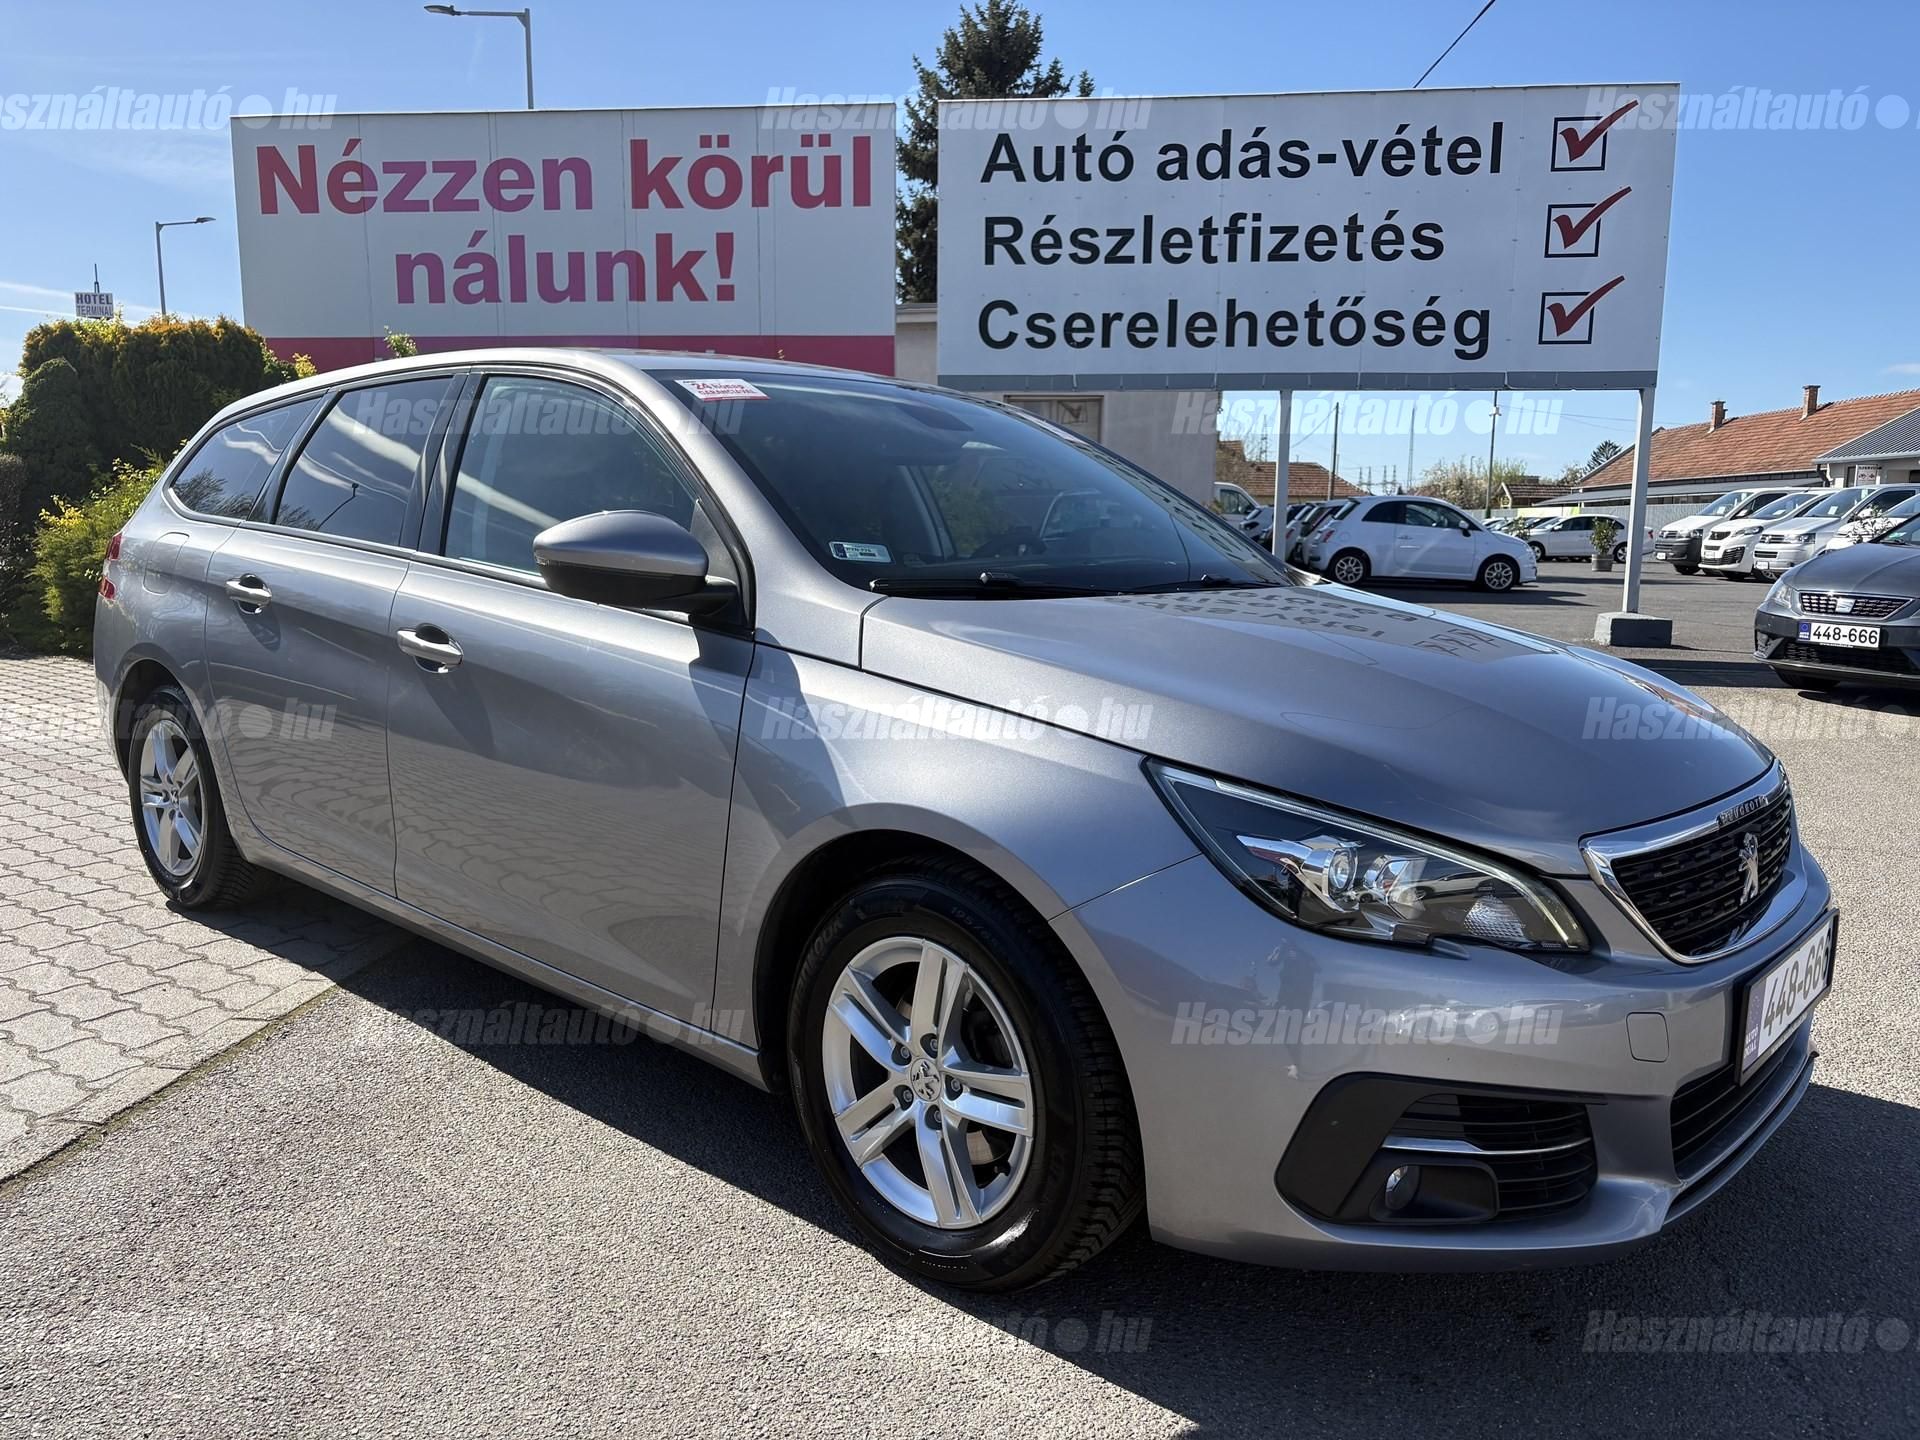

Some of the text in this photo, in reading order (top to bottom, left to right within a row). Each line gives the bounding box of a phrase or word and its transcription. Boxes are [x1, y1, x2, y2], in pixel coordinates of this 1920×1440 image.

[256, 132, 872, 215] Nézzen körül
[980, 121, 1503, 184] Autó adás-vétel
[983, 209, 1445, 265] Részletfizetés
[395, 230, 735, 304] nálunk!
[75, 294, 112, 304] HOTEL
[77, 305, 113, 316] TERMINAL
[978, 295, 1491, 361] Cserelehetőség
[1813, 625, 1878, 645] 448-666
[1720, 797, 1761, 825] PEUGEOT
[1763, 927, 1832, 1037] 448-666
